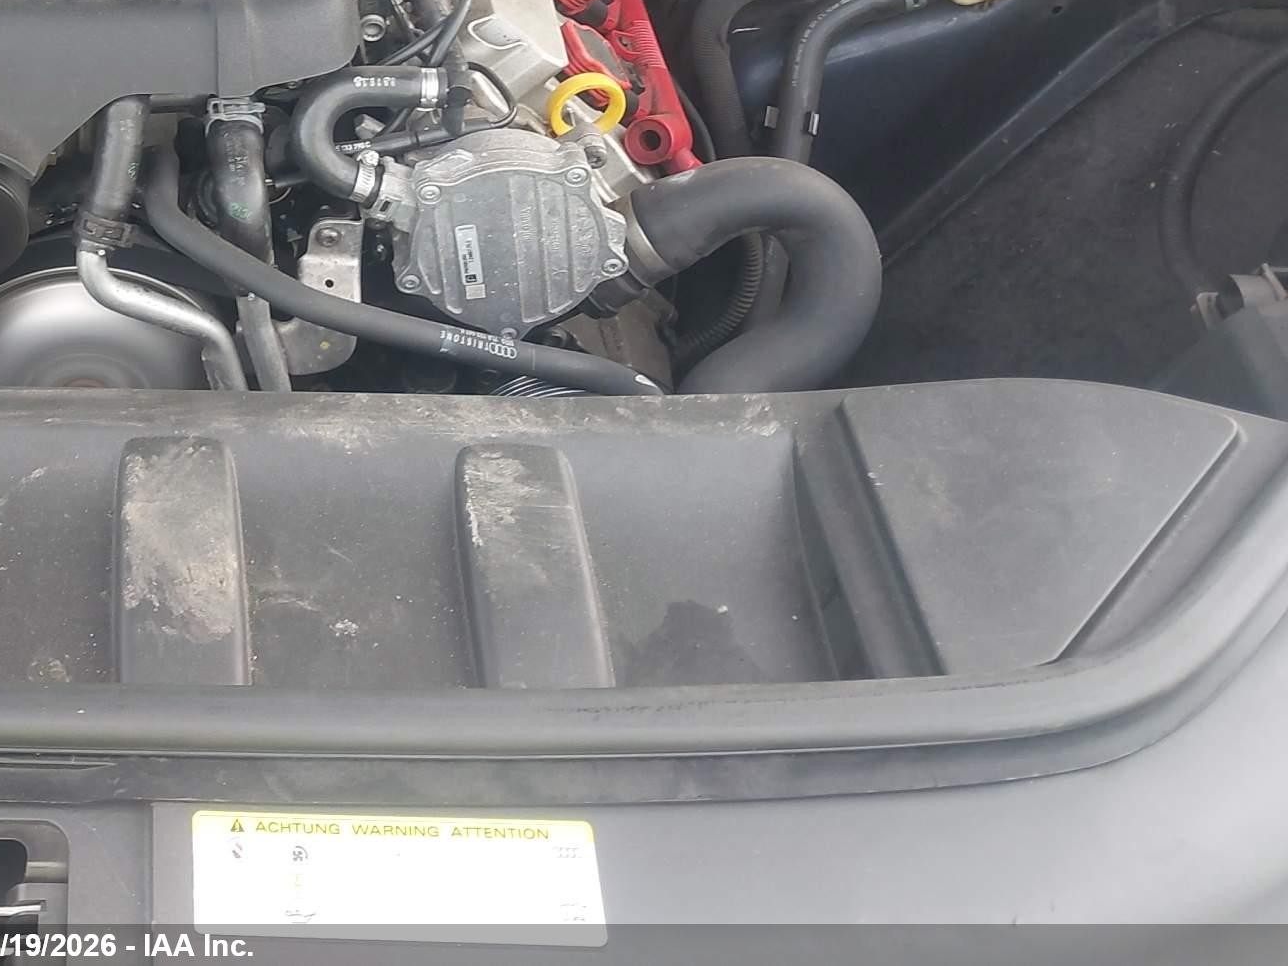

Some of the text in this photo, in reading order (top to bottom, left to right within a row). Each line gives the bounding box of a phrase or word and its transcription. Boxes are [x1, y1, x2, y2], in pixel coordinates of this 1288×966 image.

[255, 821, 550, 840] ACHTUNG WARNING ATTENTION
